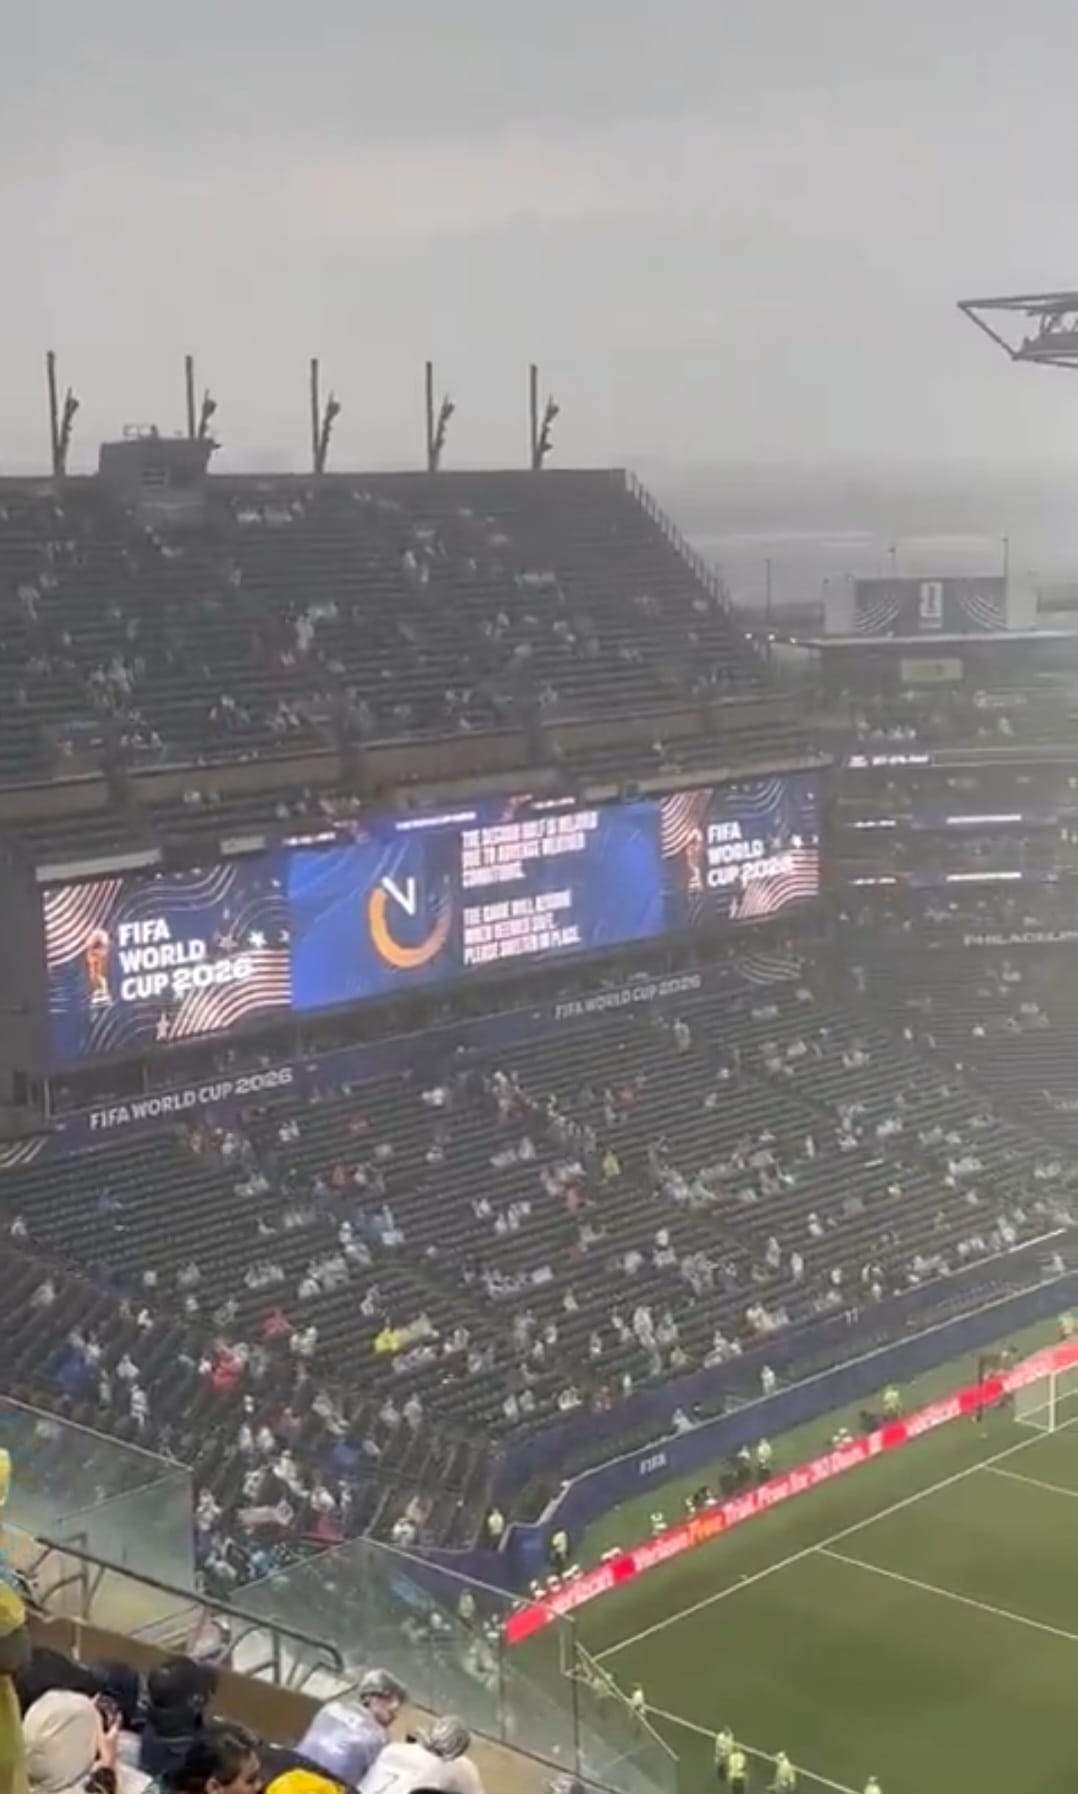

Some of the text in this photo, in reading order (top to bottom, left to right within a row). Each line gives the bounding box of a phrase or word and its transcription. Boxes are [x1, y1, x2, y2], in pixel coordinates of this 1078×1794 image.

[708, 821, 742, 844] FIFA
[707, 839, 765, 866] WORLD
[707, 865, 740, 888] CUP
[118, 917, 171, 947] FIFA
[119, 938, 207, 974] WORLD
[121, 957, 252, 1001] CUP 2026
[89, 1067, 294, 1131] FIFA WORLD CUP 2026
